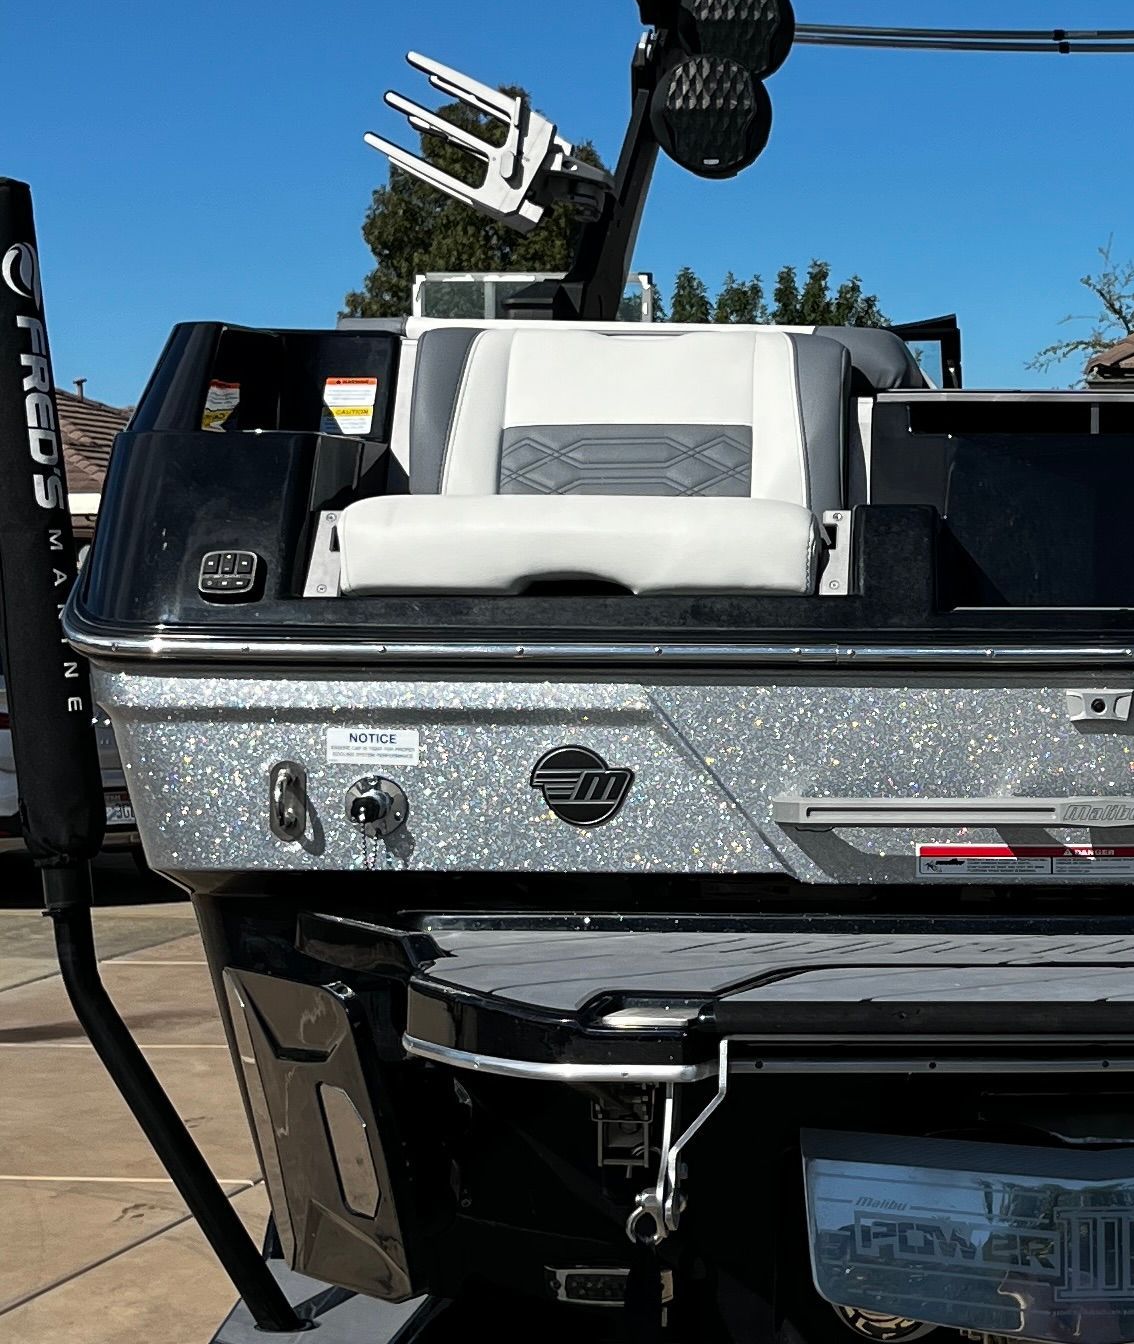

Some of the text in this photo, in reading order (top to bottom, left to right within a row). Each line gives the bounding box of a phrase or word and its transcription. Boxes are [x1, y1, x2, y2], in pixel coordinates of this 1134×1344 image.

[17, 315, 65, 511] FRED'S
[349, 733, 397, 744] NOTICE
[855, 1196, 909, 1211] Malibu
[860, 1218, 1056, 1270] POWER
